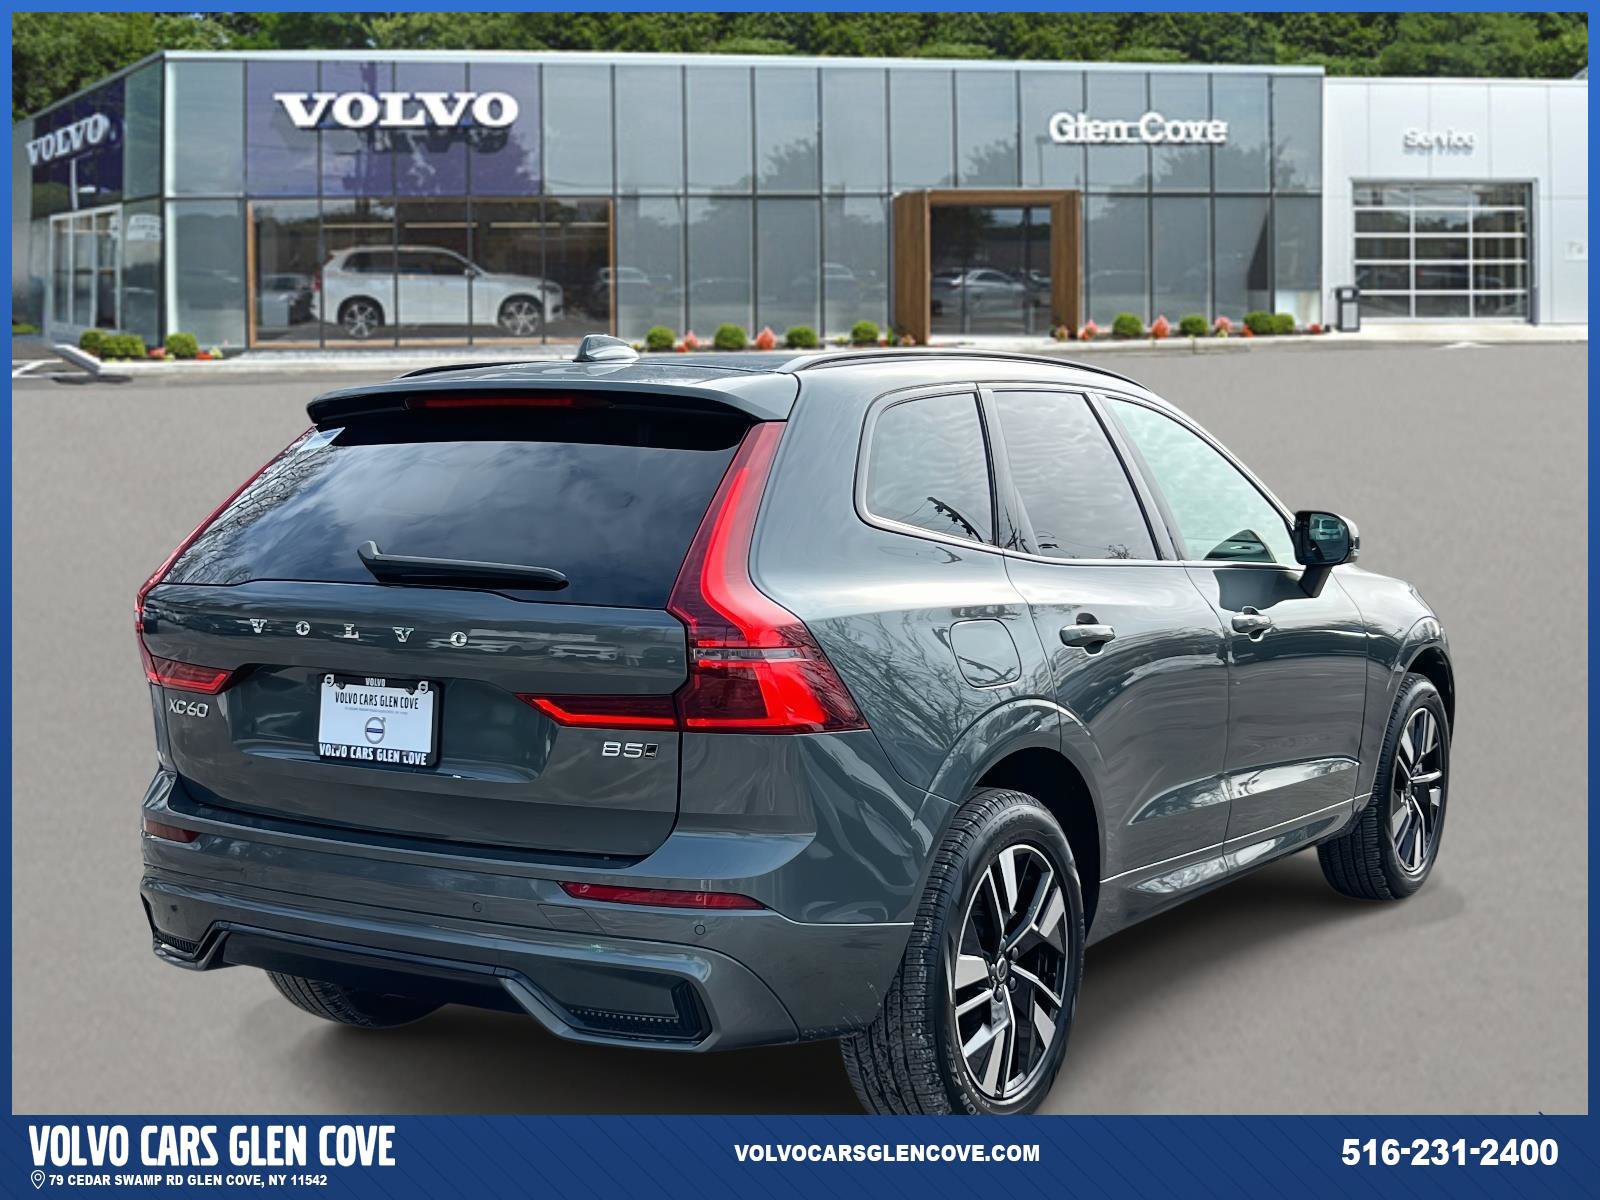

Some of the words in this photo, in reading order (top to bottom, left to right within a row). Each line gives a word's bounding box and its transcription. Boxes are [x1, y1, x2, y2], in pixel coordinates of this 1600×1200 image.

[274, 92, 519, 128] VOLVO
[1049, 112, 1128, 143] Glen
[1138, 112, 1228, 143] Cove
[1402, 127, 1475, 149] Service
[25, 113, 110, 166] VOLVO
[249, 618, 469, 647] VOLVO
[365, 677, 386, 687] VOLVO
[168, 698, 209, 718] XC60
[335, 691, 358, 704] VOLVO
[359, 694, 378, 706] CARS
[379, 695, 398, 709] GLEN
[400, 697, 419, 709] COVE
[350, 747, 374, 760] CARS
[376, 749, 400, 763] GLEN
[602, 741, 643, 758] B5
